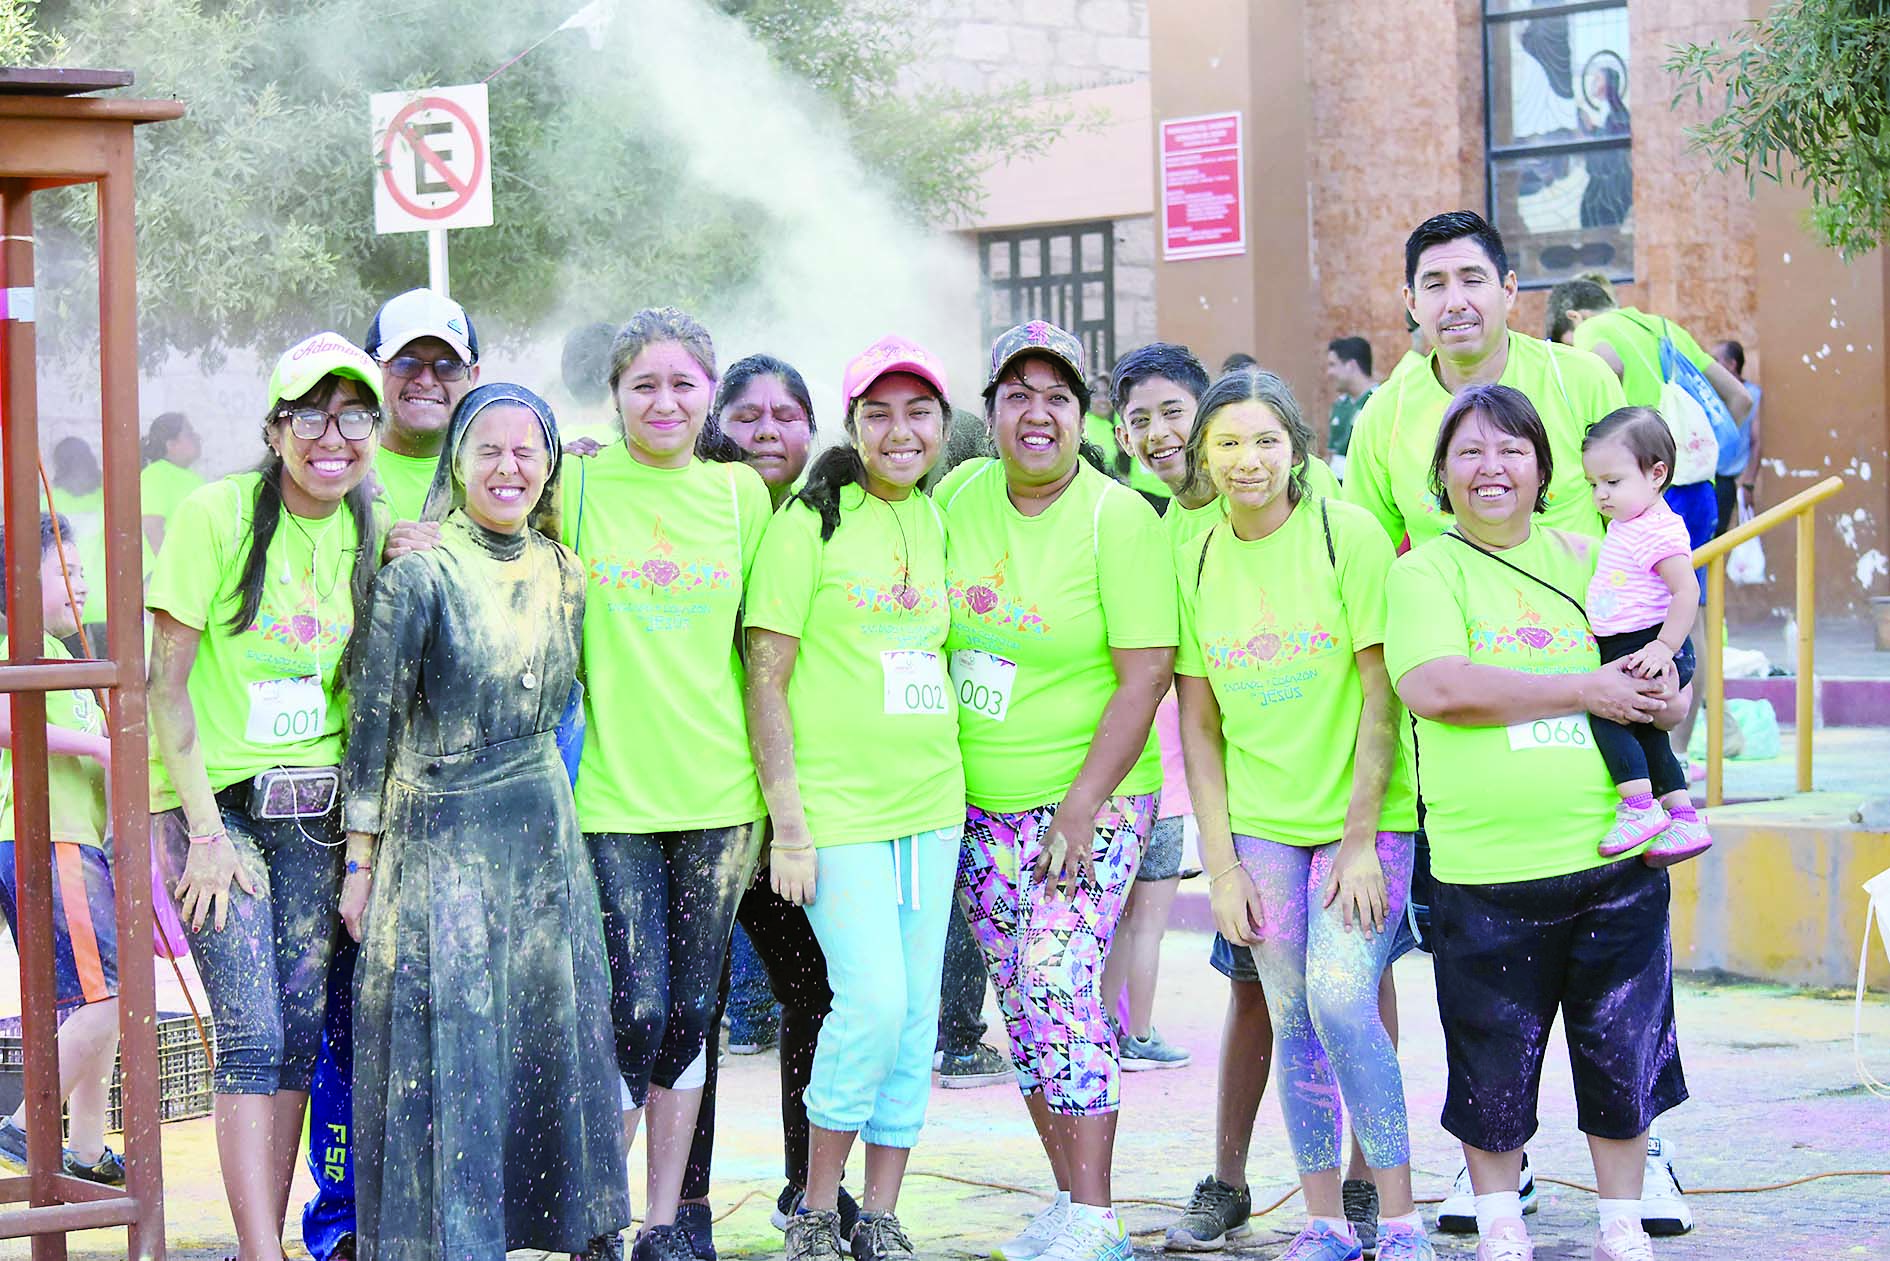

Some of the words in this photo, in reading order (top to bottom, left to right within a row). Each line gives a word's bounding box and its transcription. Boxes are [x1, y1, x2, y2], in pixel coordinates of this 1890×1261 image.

[414, 121, 457, 195] E
[905, 683, 945, 709] 002
[960, 679, 1003, 715] 003
[273, 707, 319, 737] 001
[1532, 720, 1586, 745] 066
